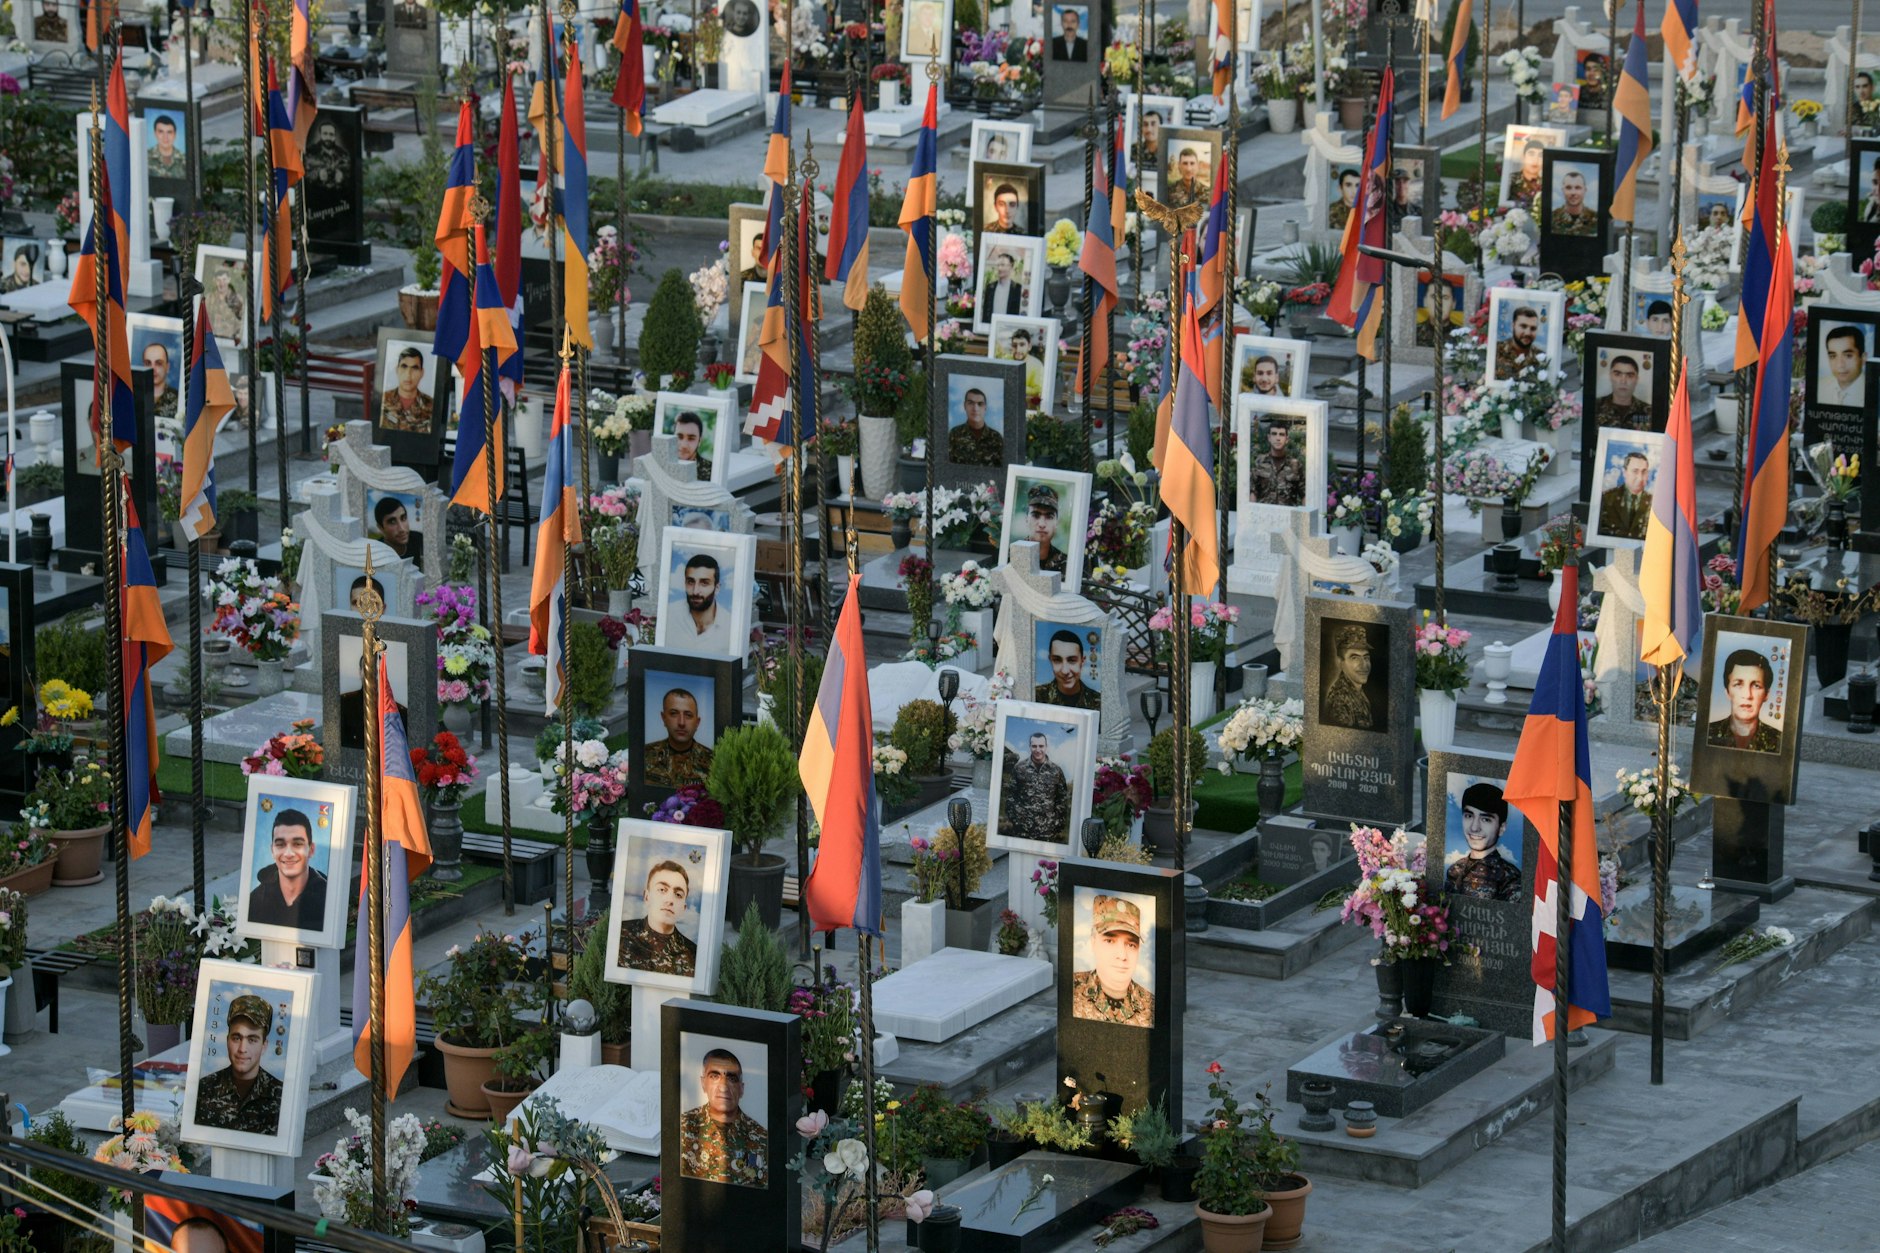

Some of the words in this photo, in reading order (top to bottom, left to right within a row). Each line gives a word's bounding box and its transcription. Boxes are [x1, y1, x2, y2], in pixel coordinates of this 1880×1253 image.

[1817, 422, 1864, 434] ՎԱՐՈՒԺԱ
[1327, 750, 1380, 769] ԱՎԵՏԻՍ
[1327, 779, 1348, 790] 2000
[1358, 783, 1379, 794] 2020
[1459, 904, 1505, 924] ՀՐԱՆՏ
